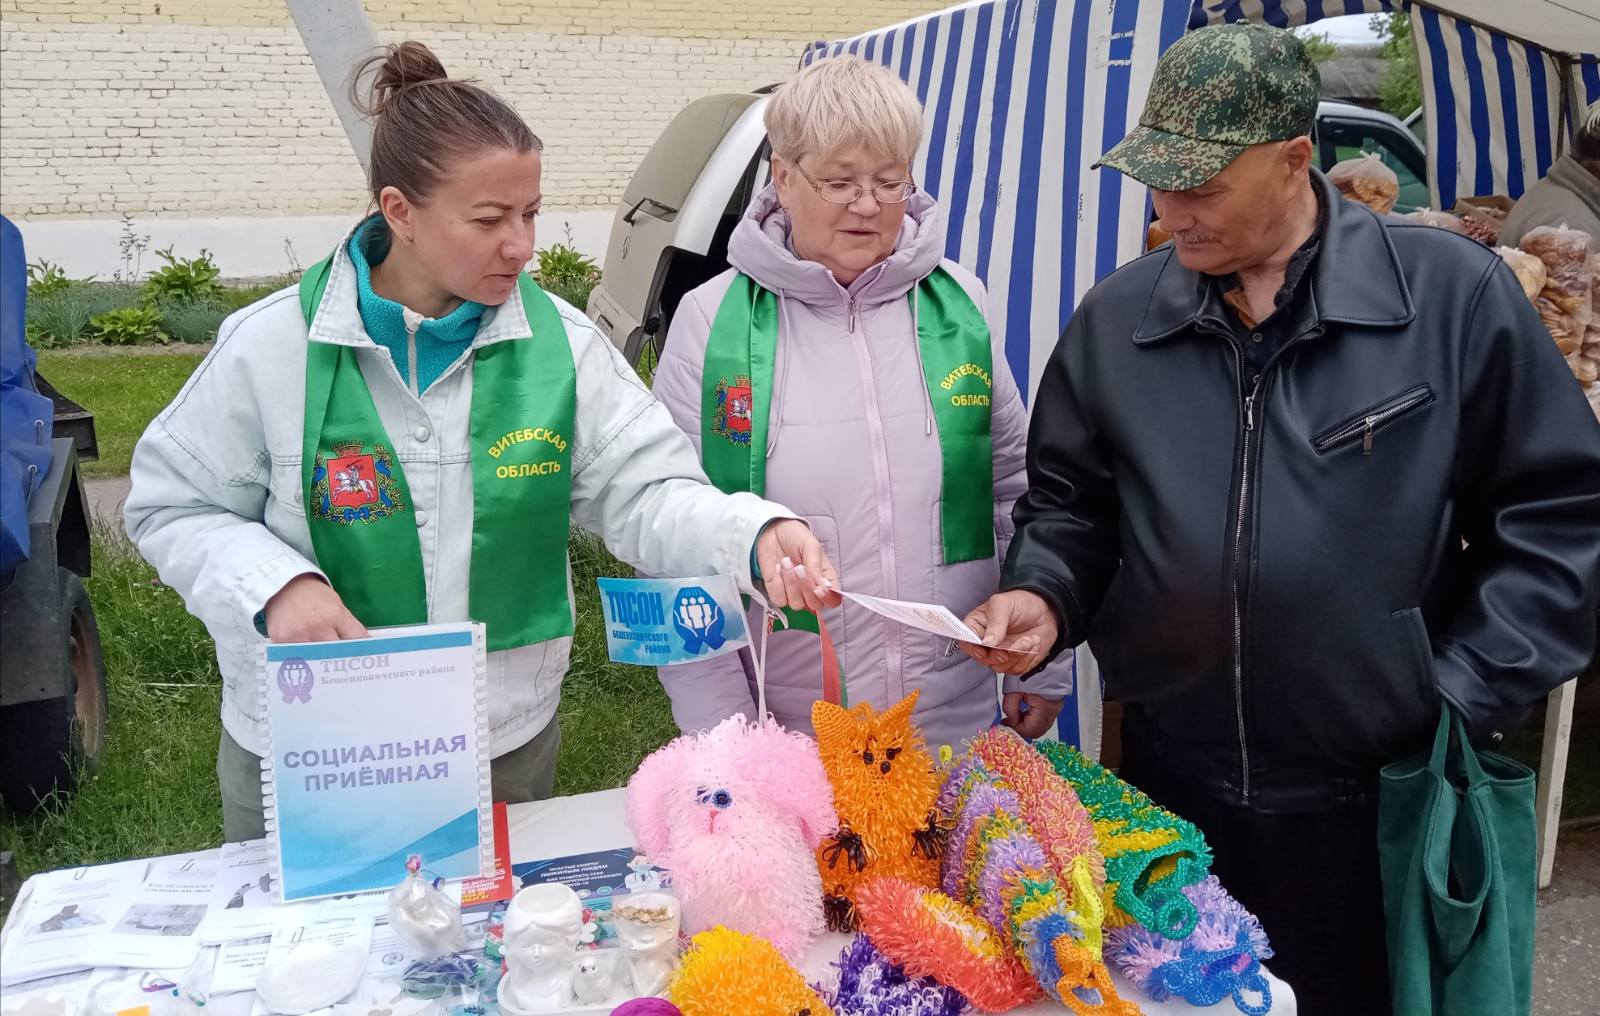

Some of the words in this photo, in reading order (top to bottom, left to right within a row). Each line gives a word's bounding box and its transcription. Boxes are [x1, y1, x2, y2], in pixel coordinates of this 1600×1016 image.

[941, 364, 992, 390] ВИТЕБСКАЯ
[951, 394, 990, 407] ОБЛАСТЬ
[488, 428, 567, 459] ВИТЕБСКАЯ
[496, 461, 561, 478] ОБЛАСТЬ
[606, 591, 665, 628] ТЦСОН
[644, 644, 672, 655] РАЙОНА
[319, 655, 390, 673] ТЦСОН
[418, 665, 456, 678] района
[283, 734, 467, 769] СОЦИАЛЬНАЯ
[304, 761, 449, 792] ПРИЁМНАЯ
